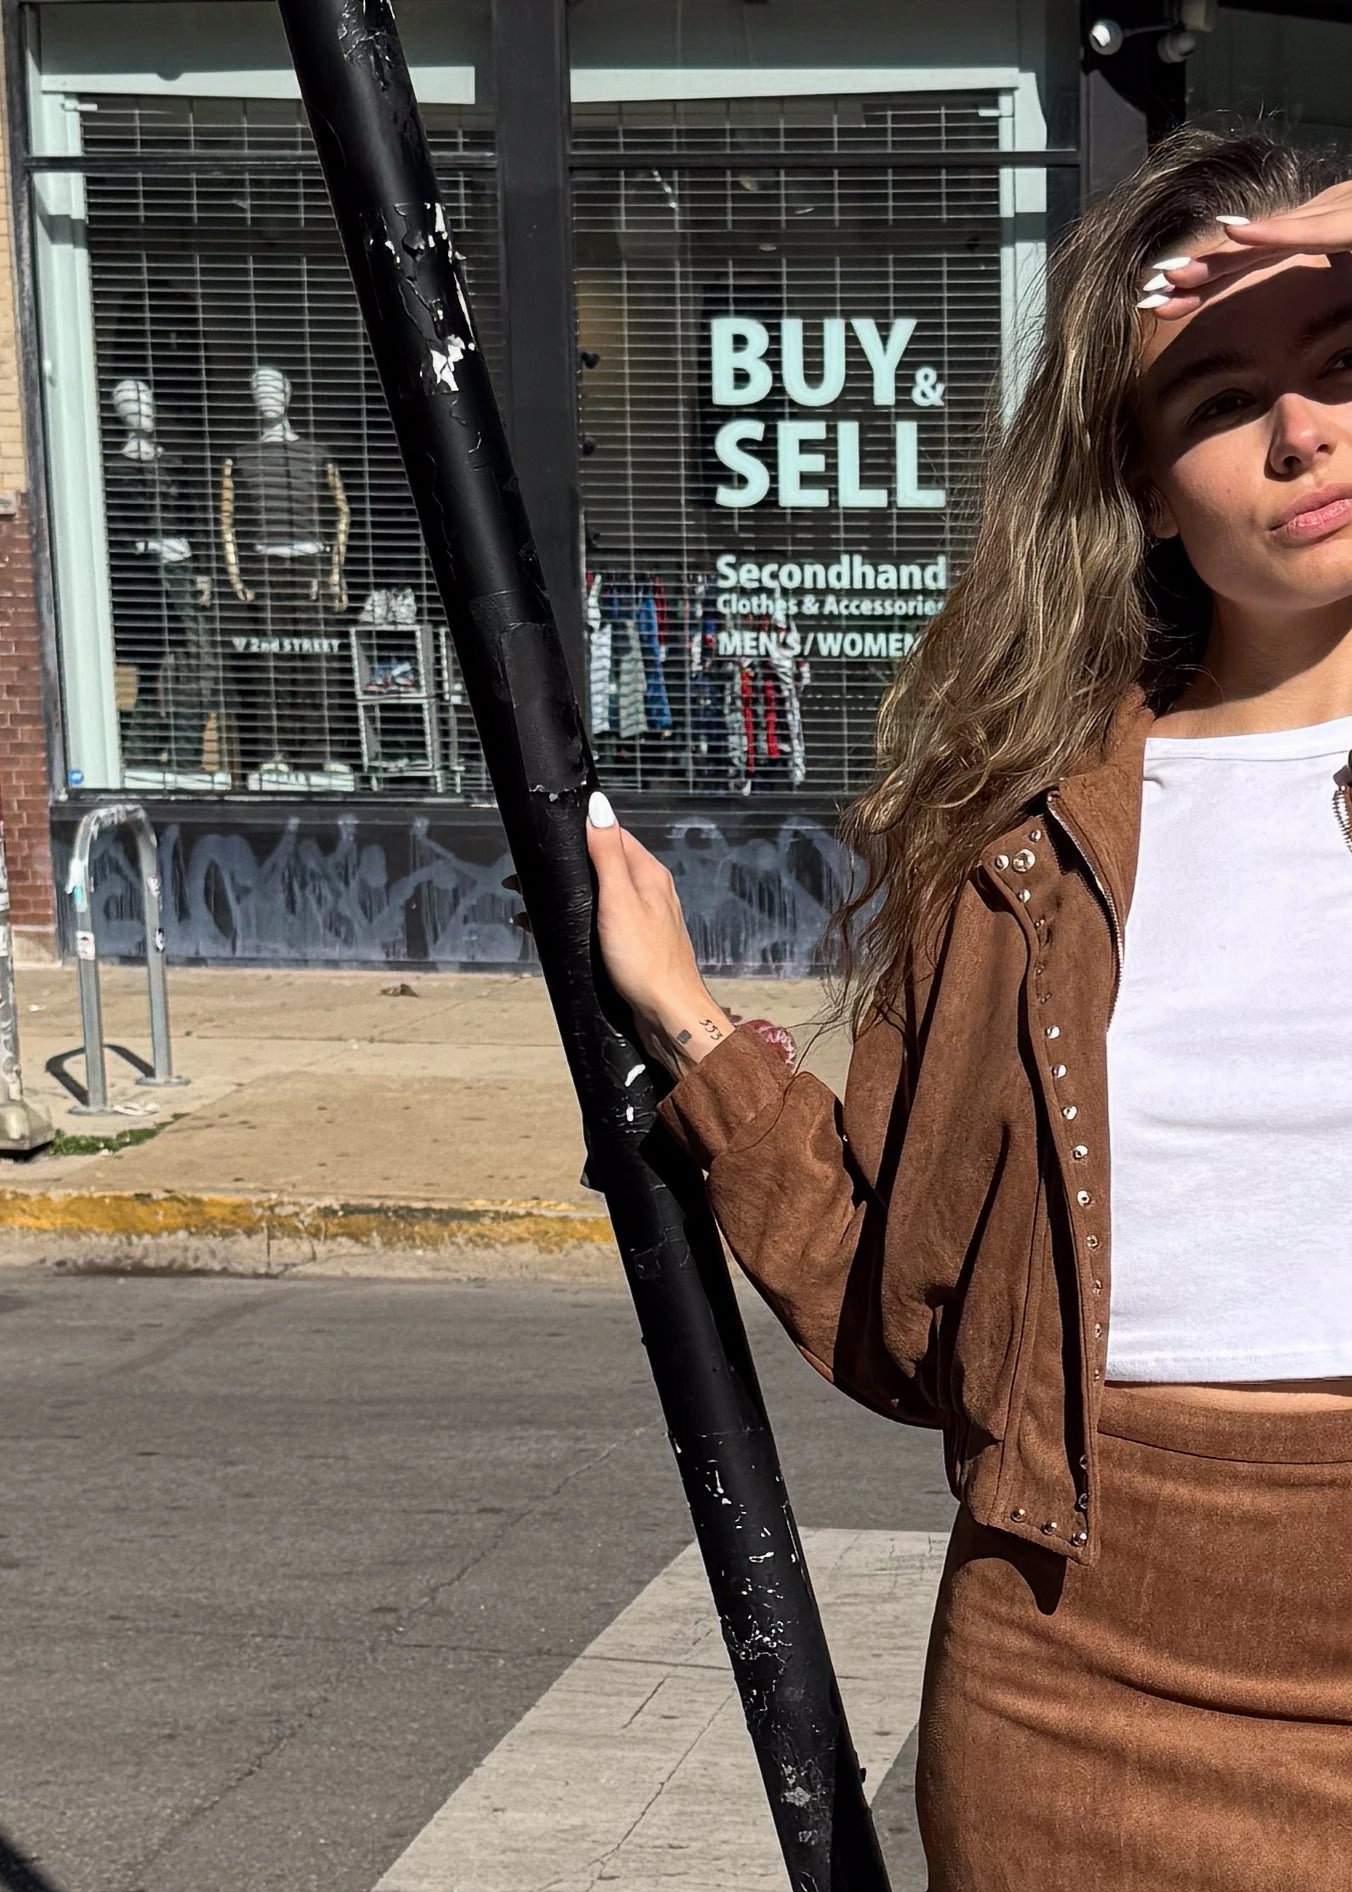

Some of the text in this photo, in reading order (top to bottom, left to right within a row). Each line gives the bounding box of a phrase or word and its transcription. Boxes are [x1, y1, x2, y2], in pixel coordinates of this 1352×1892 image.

[711, 318, 945, 406] BUY &
[714, 419, 946, 508] SELL
[716, 554, 947, 590] Secondhand
[717, 593, 798, 615] Clothes
[802, 594, 819, 615] &
